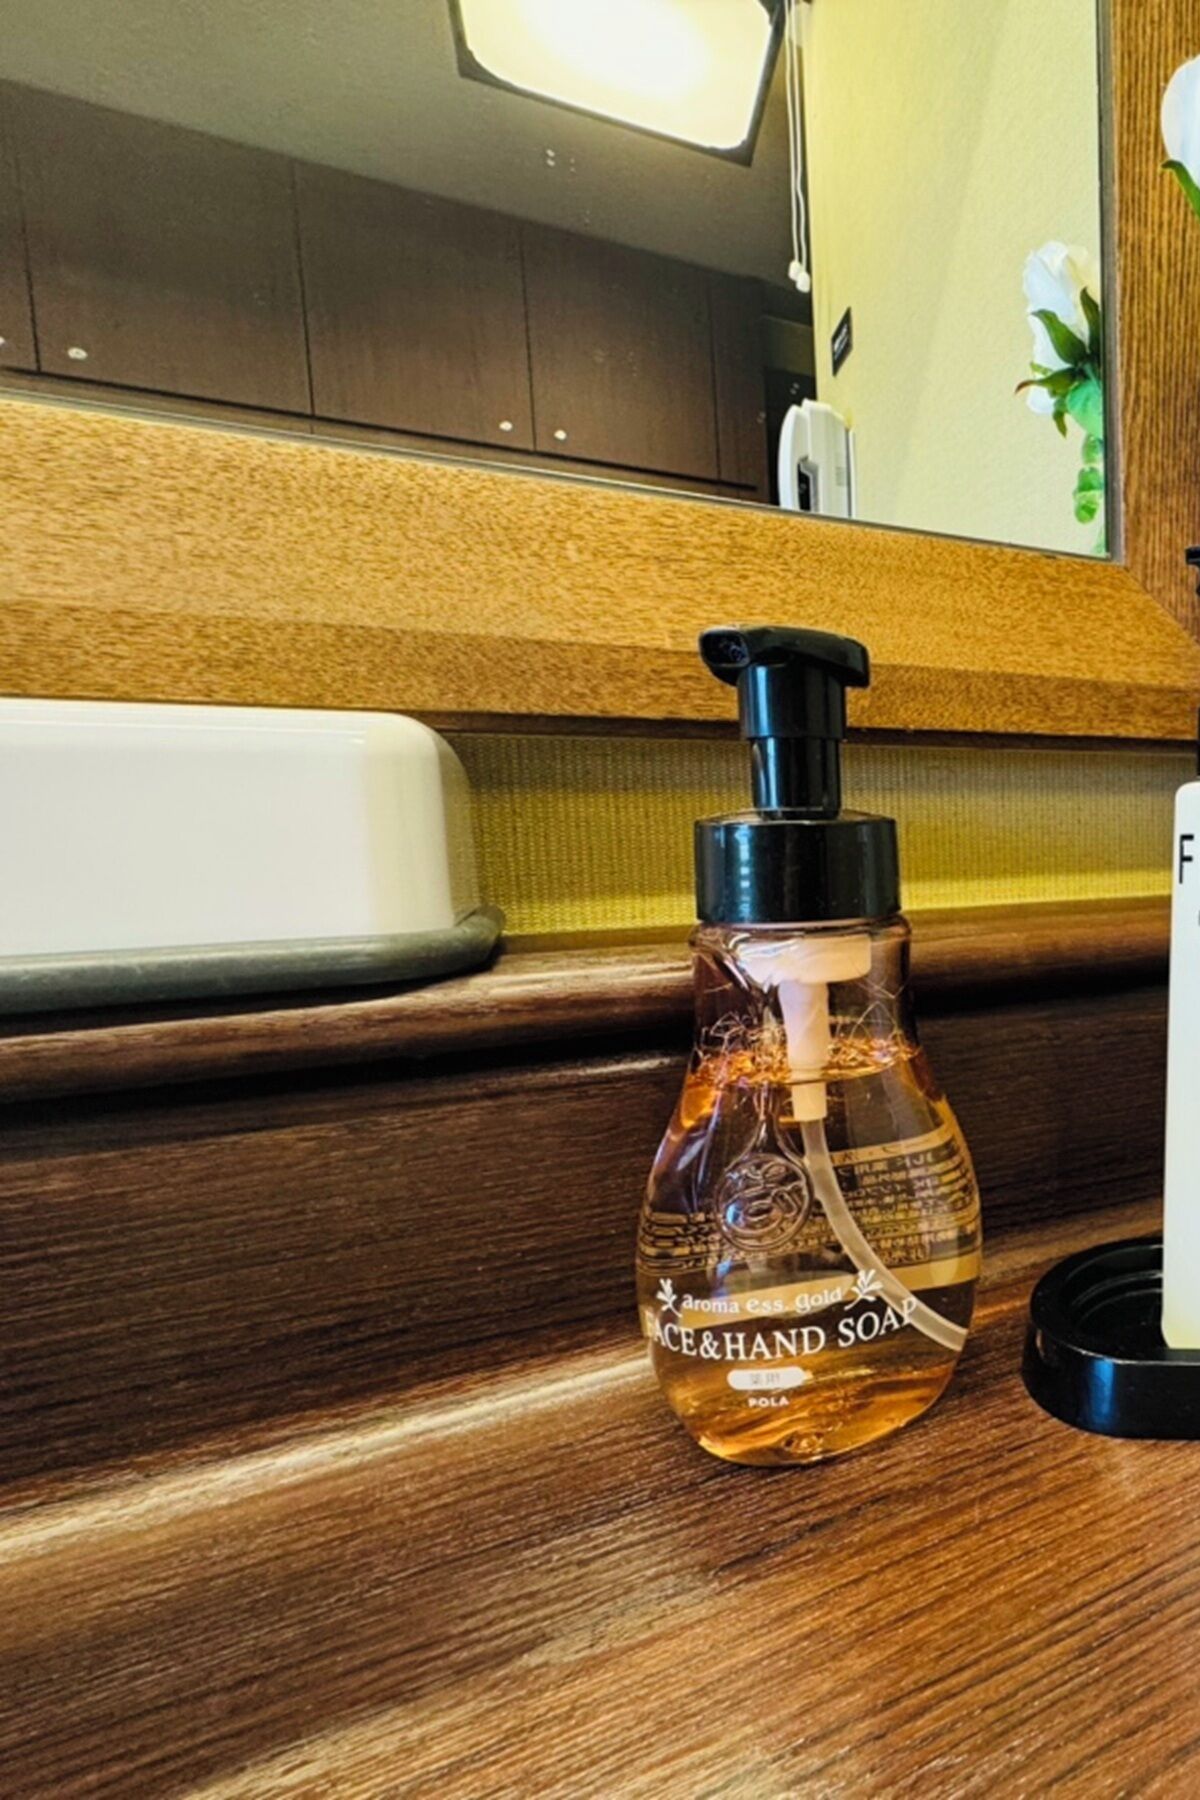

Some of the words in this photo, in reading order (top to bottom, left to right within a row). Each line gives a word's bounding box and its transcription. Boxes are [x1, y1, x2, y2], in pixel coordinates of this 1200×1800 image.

[681, 1293, 741, 1314] aroma
[795, 1287, 844, 1314] gold
[837, 1297, 918, 1348] SOAP
[748, 1395, 790, 1408] POLA
